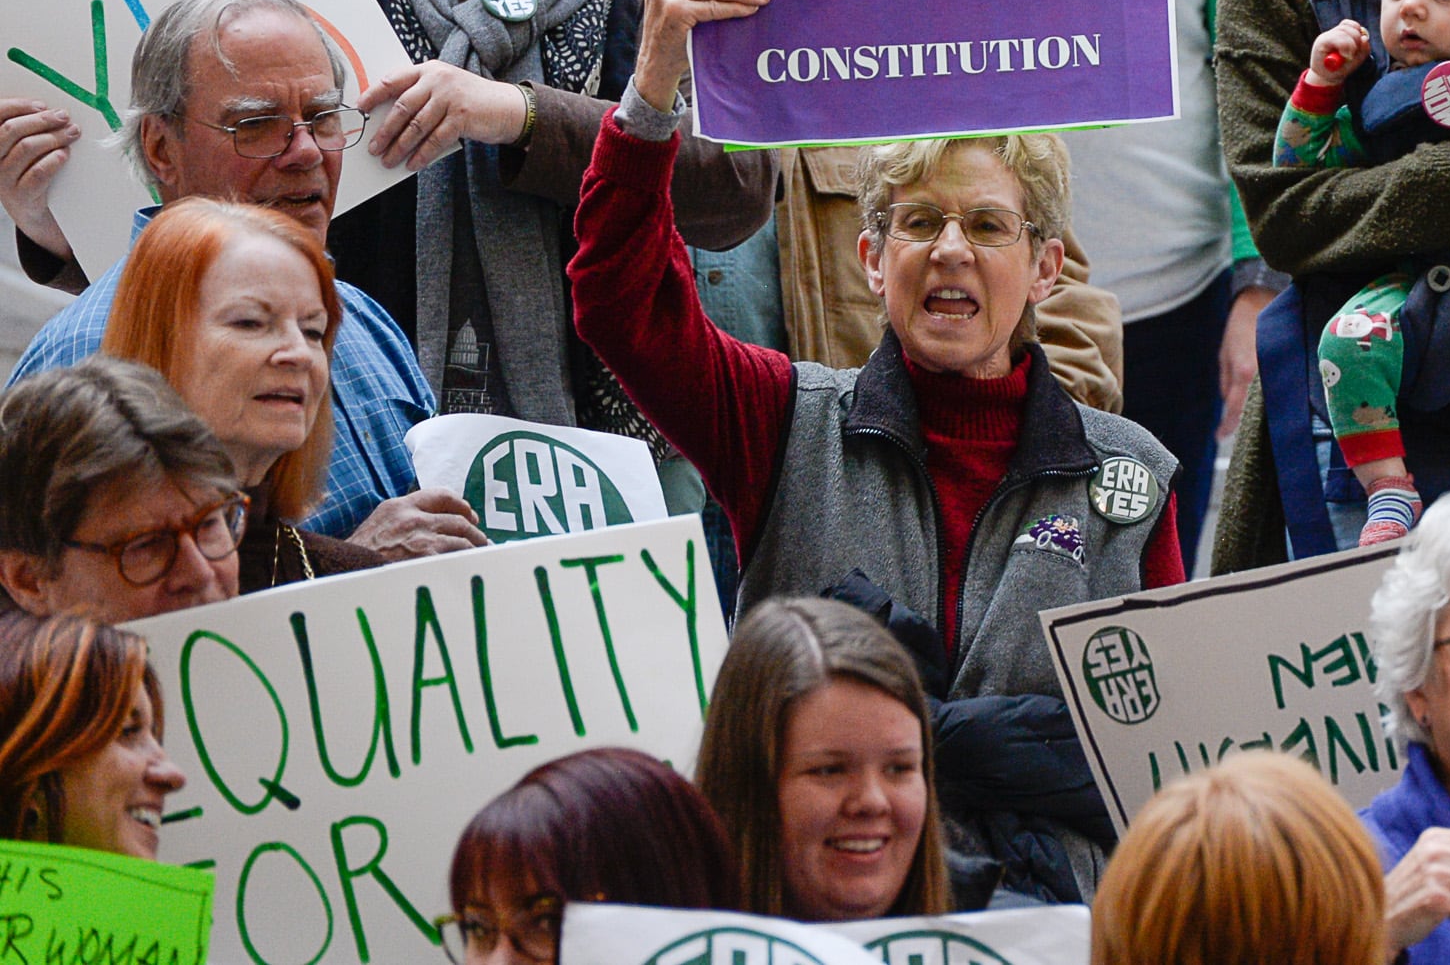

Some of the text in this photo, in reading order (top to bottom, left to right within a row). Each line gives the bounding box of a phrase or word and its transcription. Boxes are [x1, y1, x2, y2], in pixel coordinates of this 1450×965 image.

[755, 33, 1102, 84] CONSTITUTION
[482, 438, 609, 534] ERA
[1095, 486, 1150, 519] YES
[1102, 461, 1150, 494] ERA
[1087, 631, 1152, 678] YES
[163, 539, 709, 827] QUALITY
[1097, 669, 1160, 723] ERA
[182, 815, 443, 965] OR
